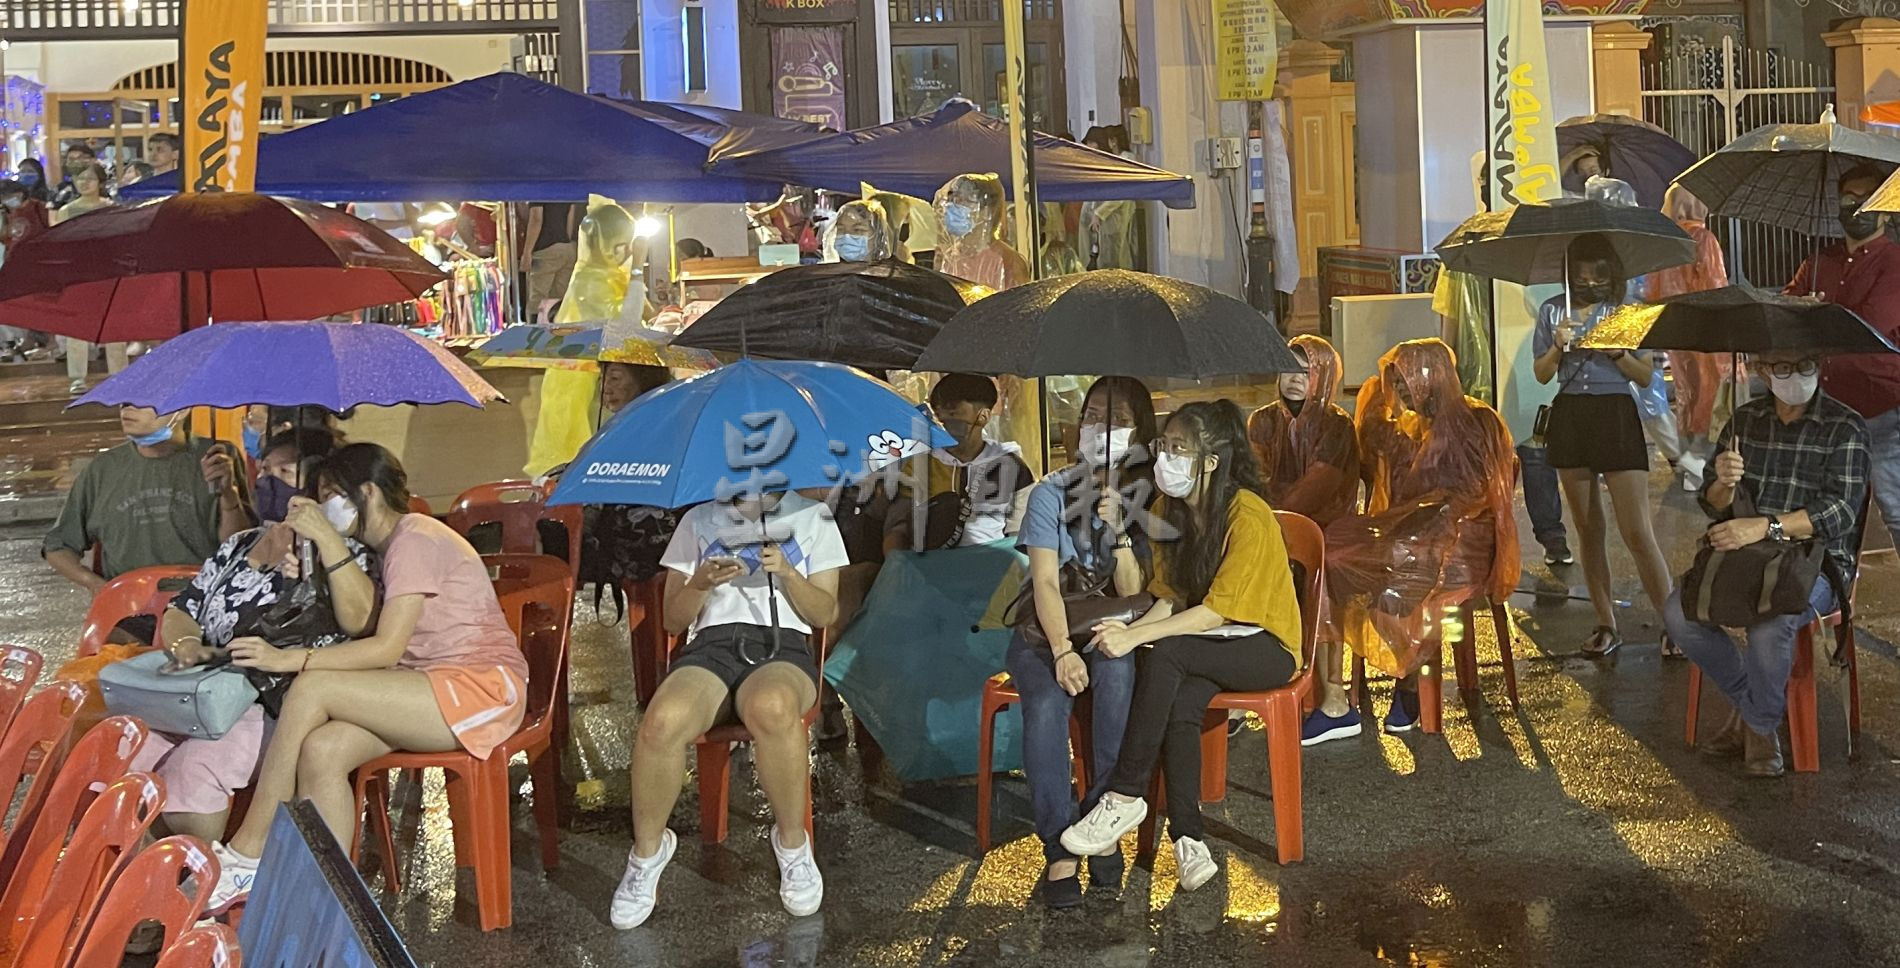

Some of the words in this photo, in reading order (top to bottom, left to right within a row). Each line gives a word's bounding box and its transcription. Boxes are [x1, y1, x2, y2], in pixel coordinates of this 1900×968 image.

[1252, 44, 1265, 53] AM
[1252, 66, 1265, 75] AM
[193, 40, 236, 193] ALAYA
[586, 462, 671, 477] DORAEMON
